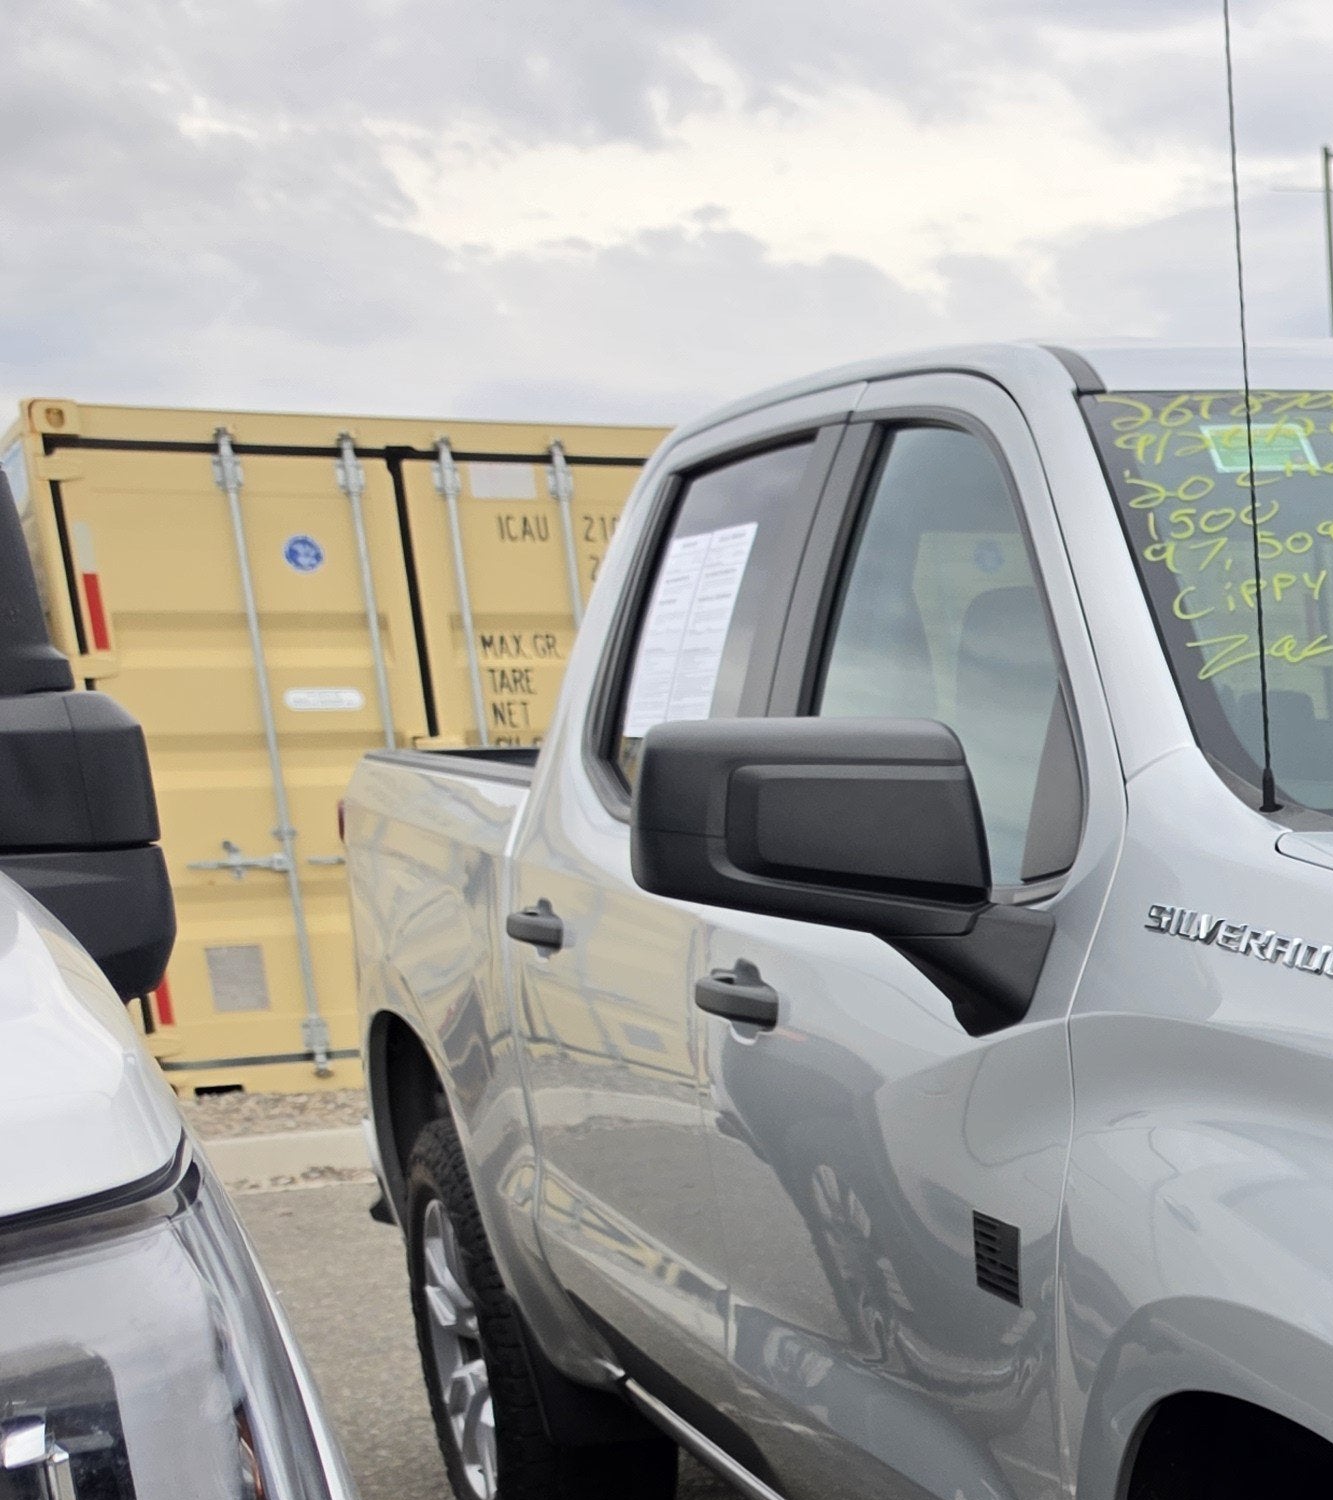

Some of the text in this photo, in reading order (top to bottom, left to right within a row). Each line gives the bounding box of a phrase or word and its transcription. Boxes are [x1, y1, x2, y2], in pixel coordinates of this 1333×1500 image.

[497, 514, 551, 542] ICAU
[488, 667, 537, 696] TARE
[491, 701, 531, 727] NET
